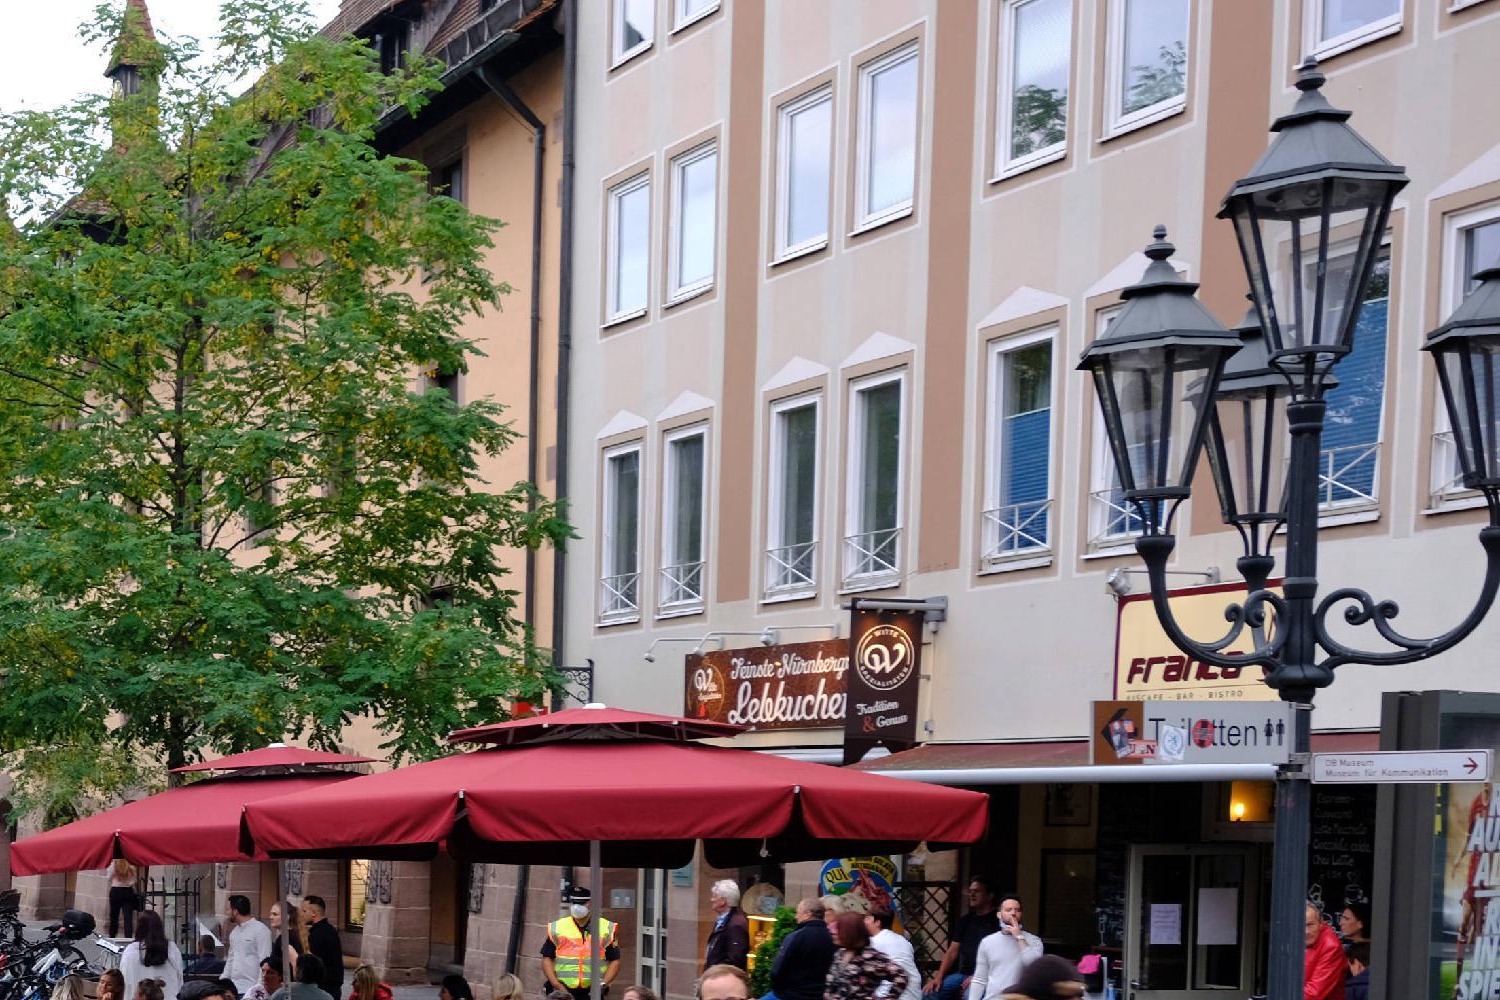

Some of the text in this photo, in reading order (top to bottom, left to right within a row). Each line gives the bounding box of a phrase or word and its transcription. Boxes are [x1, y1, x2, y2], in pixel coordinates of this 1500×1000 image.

[731, 656, 776, 680] Feinste
[1208, 690, 1244, 699] BISTRO
[855, 700, 900, 716] Tradition
[862, 714, 909, 732] & Genuss
[1148, 717, 1257, 747] Tltten
[1339, 758, 1375, 767] Museum
[1325, 768, 1360, 777] Museum
[1381, 766, 1450, 777] Kommunikation
